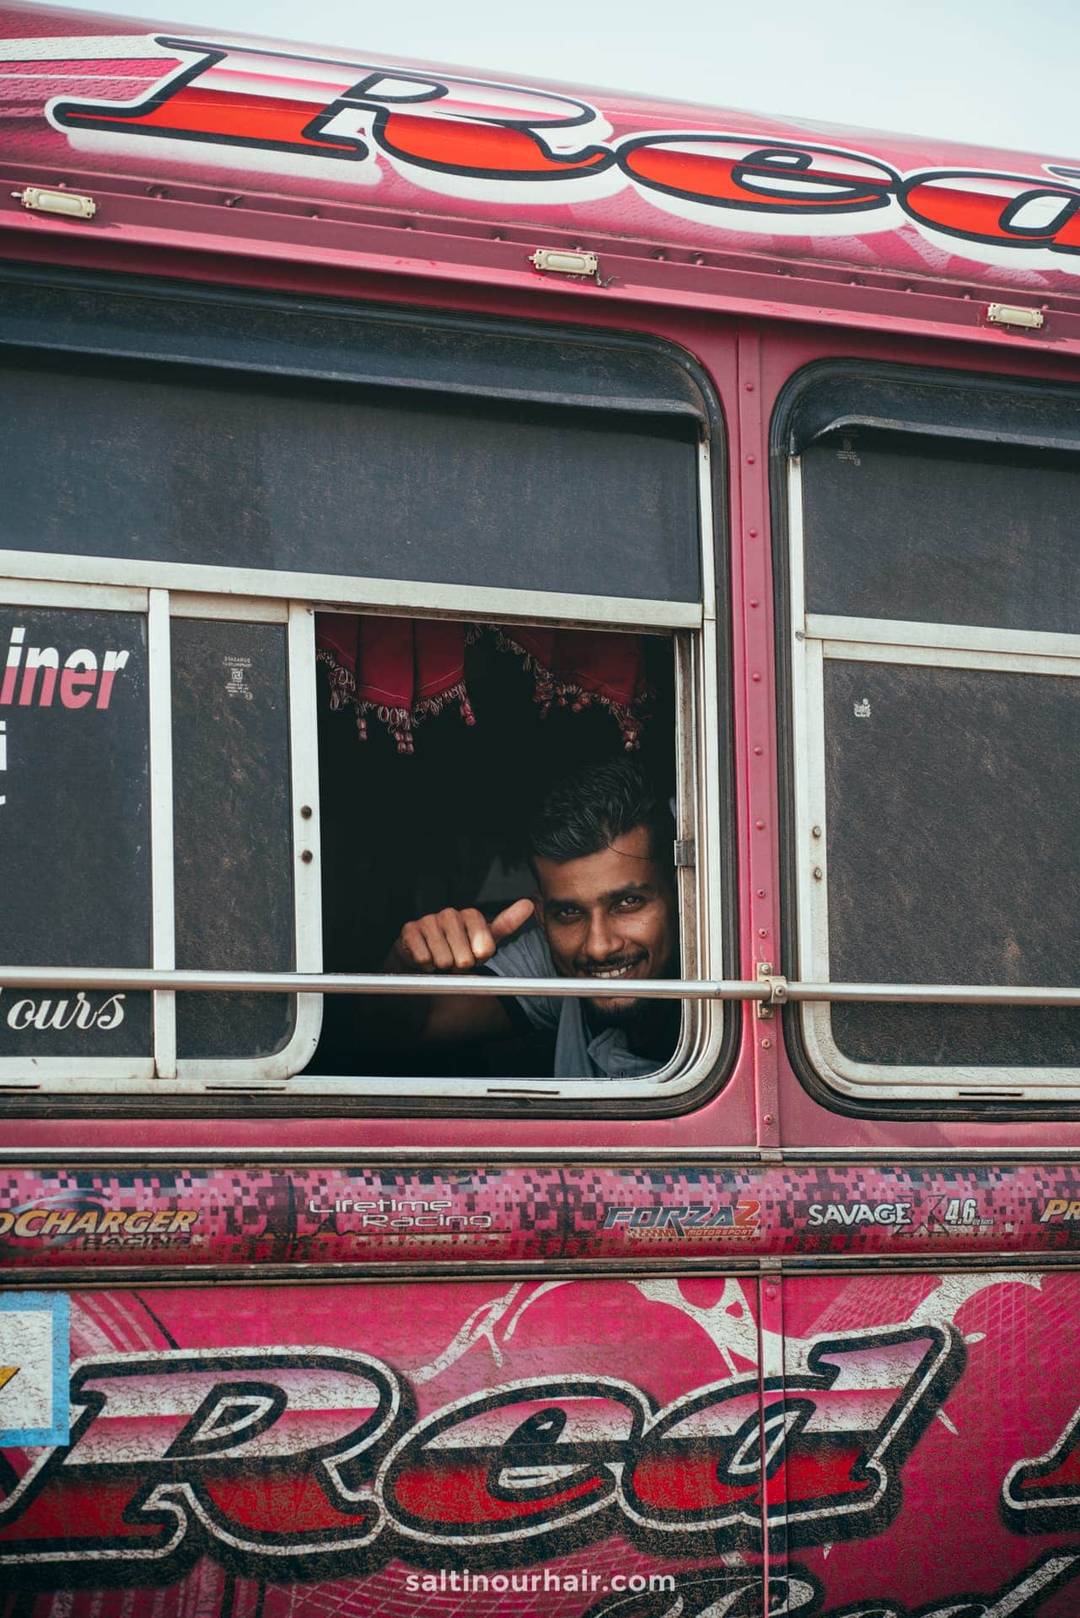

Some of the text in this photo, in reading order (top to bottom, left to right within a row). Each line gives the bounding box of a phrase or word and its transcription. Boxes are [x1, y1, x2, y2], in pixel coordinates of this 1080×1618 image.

[0, 987, 126, 1030] ours
[309, 1200, 452, 1213] Lifetime
[362, 1214, 492, 1228] Racing
[603, 1200, 761, 1237] FORZA 2
[807, 1203, 912, 1225] SAVAGE
[0, 1320, 960, 1572] Red
